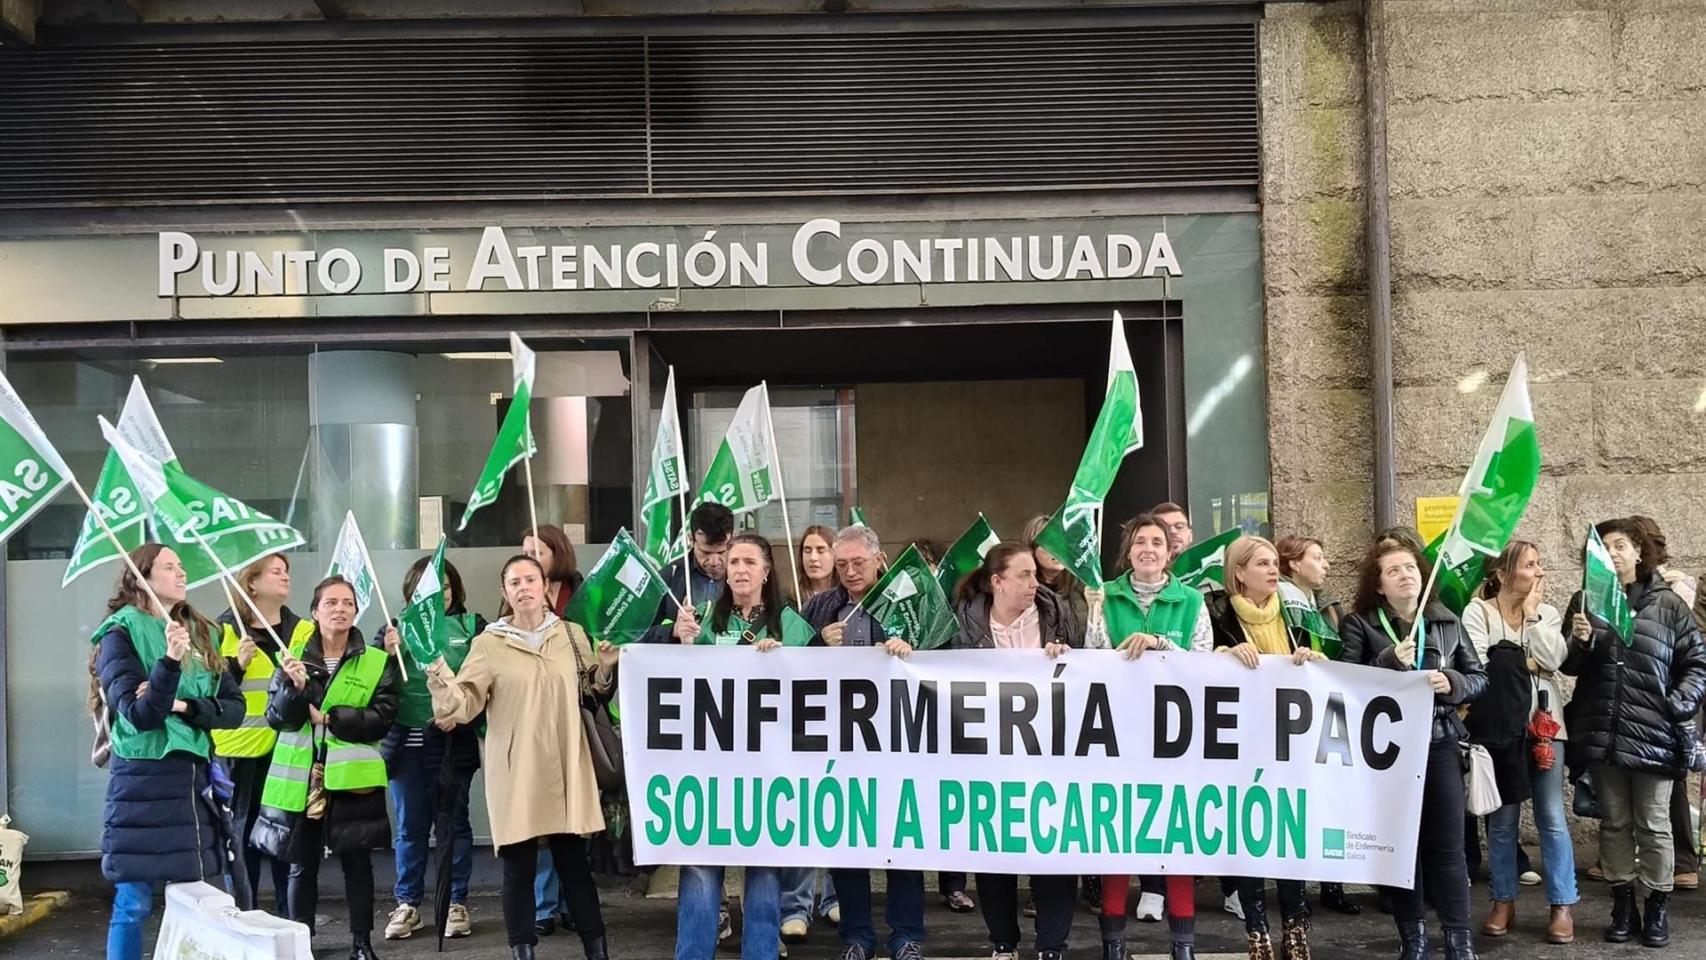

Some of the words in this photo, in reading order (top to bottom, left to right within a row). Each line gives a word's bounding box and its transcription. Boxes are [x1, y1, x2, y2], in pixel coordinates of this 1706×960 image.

[158, 231, 361, 297] PUNTO
[384, 247, 452, 293] DE
[466, 226, 769, 292] ATENCIÓN
[792, 219, 1183, 285] CONTINUADA
[647, 664, 1120, 757] ENFERMERÍA
[1153, 684, 1240, 760] DE
[1276, 687, 1403, 770] PAC
[645, 760, 877, 849] SOLUCIÓN
[893, 778, 925, 849] A
[940, 768, 1307, 859] PRECARIZACIÓN
[1346, 831, 1377, 842] Sindicato
[1346, 841, 1354, 850] de
[1355, 841, 1395, 853] Enfermería
